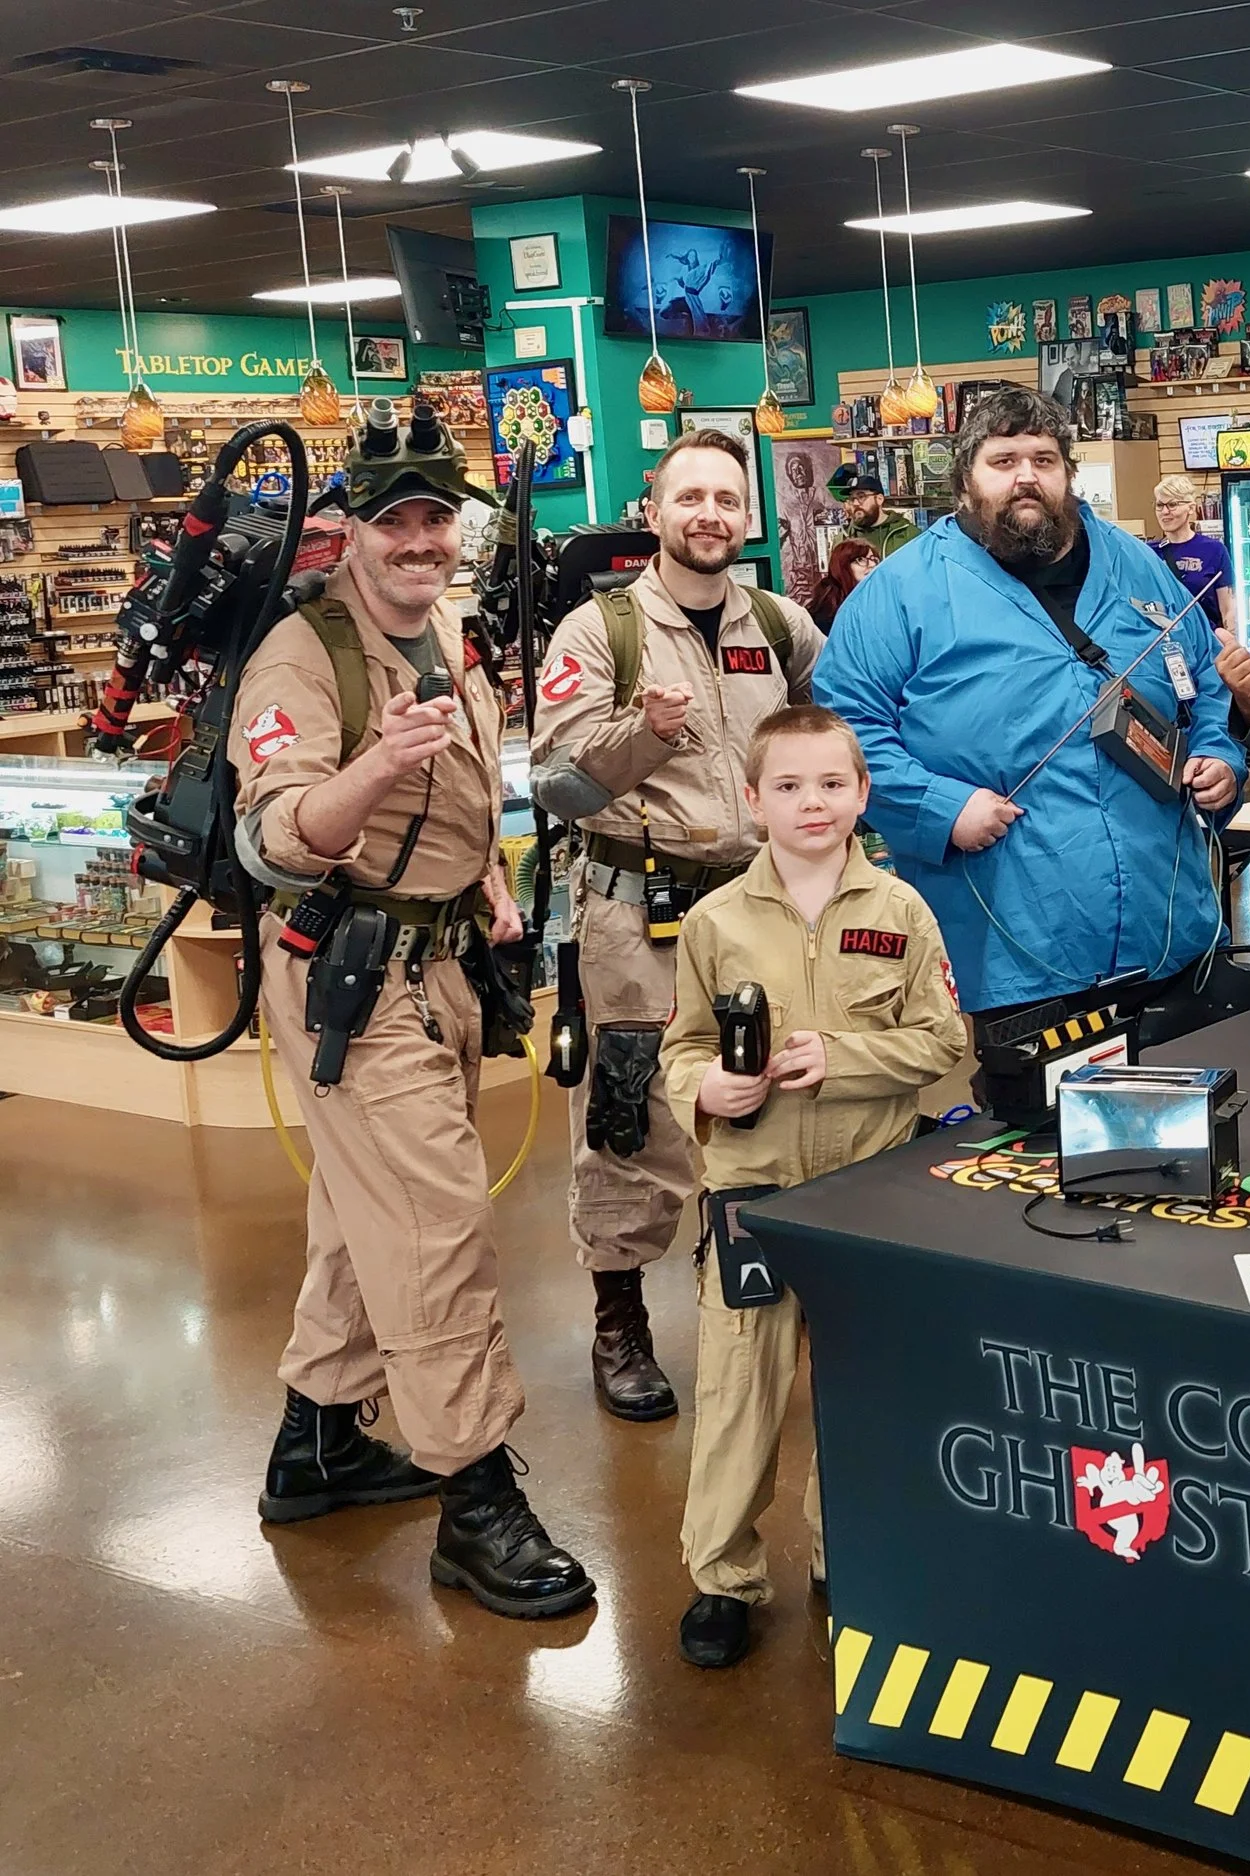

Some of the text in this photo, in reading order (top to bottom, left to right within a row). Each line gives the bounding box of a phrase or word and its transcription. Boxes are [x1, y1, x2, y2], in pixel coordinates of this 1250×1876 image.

[115, 348, 323, 377] TABLETOP GAME
[843, 931, 906, 956] HAIST
[979, 1337, 1144, 1442] THE
